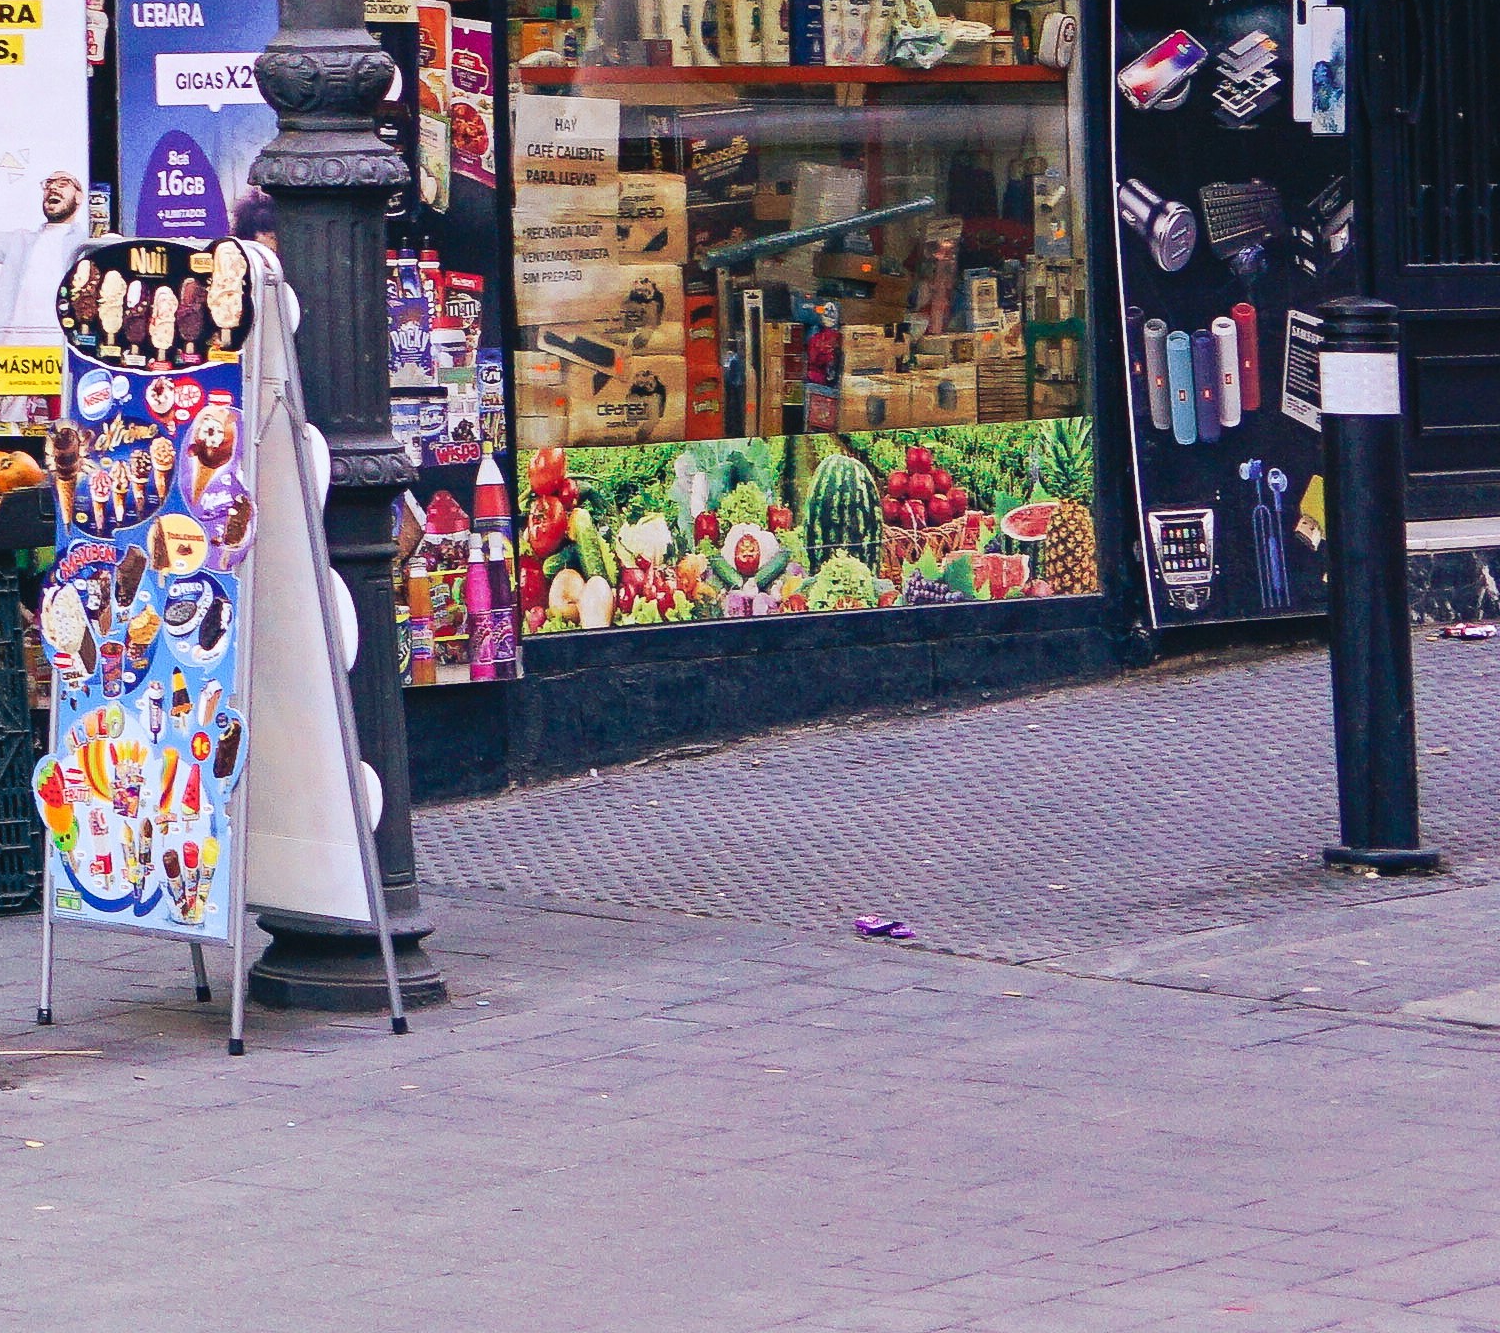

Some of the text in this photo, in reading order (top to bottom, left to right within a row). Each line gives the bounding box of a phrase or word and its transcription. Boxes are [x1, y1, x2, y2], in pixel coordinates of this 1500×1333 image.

[132, 2, 205, 29] LEBARA
[175, 71, 224, 91] GIGAS
[554, 117, 578, 133] HAY
[527, 142, 554, 159] CAFÉ
[156, 169, 205, 196] 16GB
[526, 169, 597, 186] PARA LLEVAR
[169, 582, 204, 597] OREO
